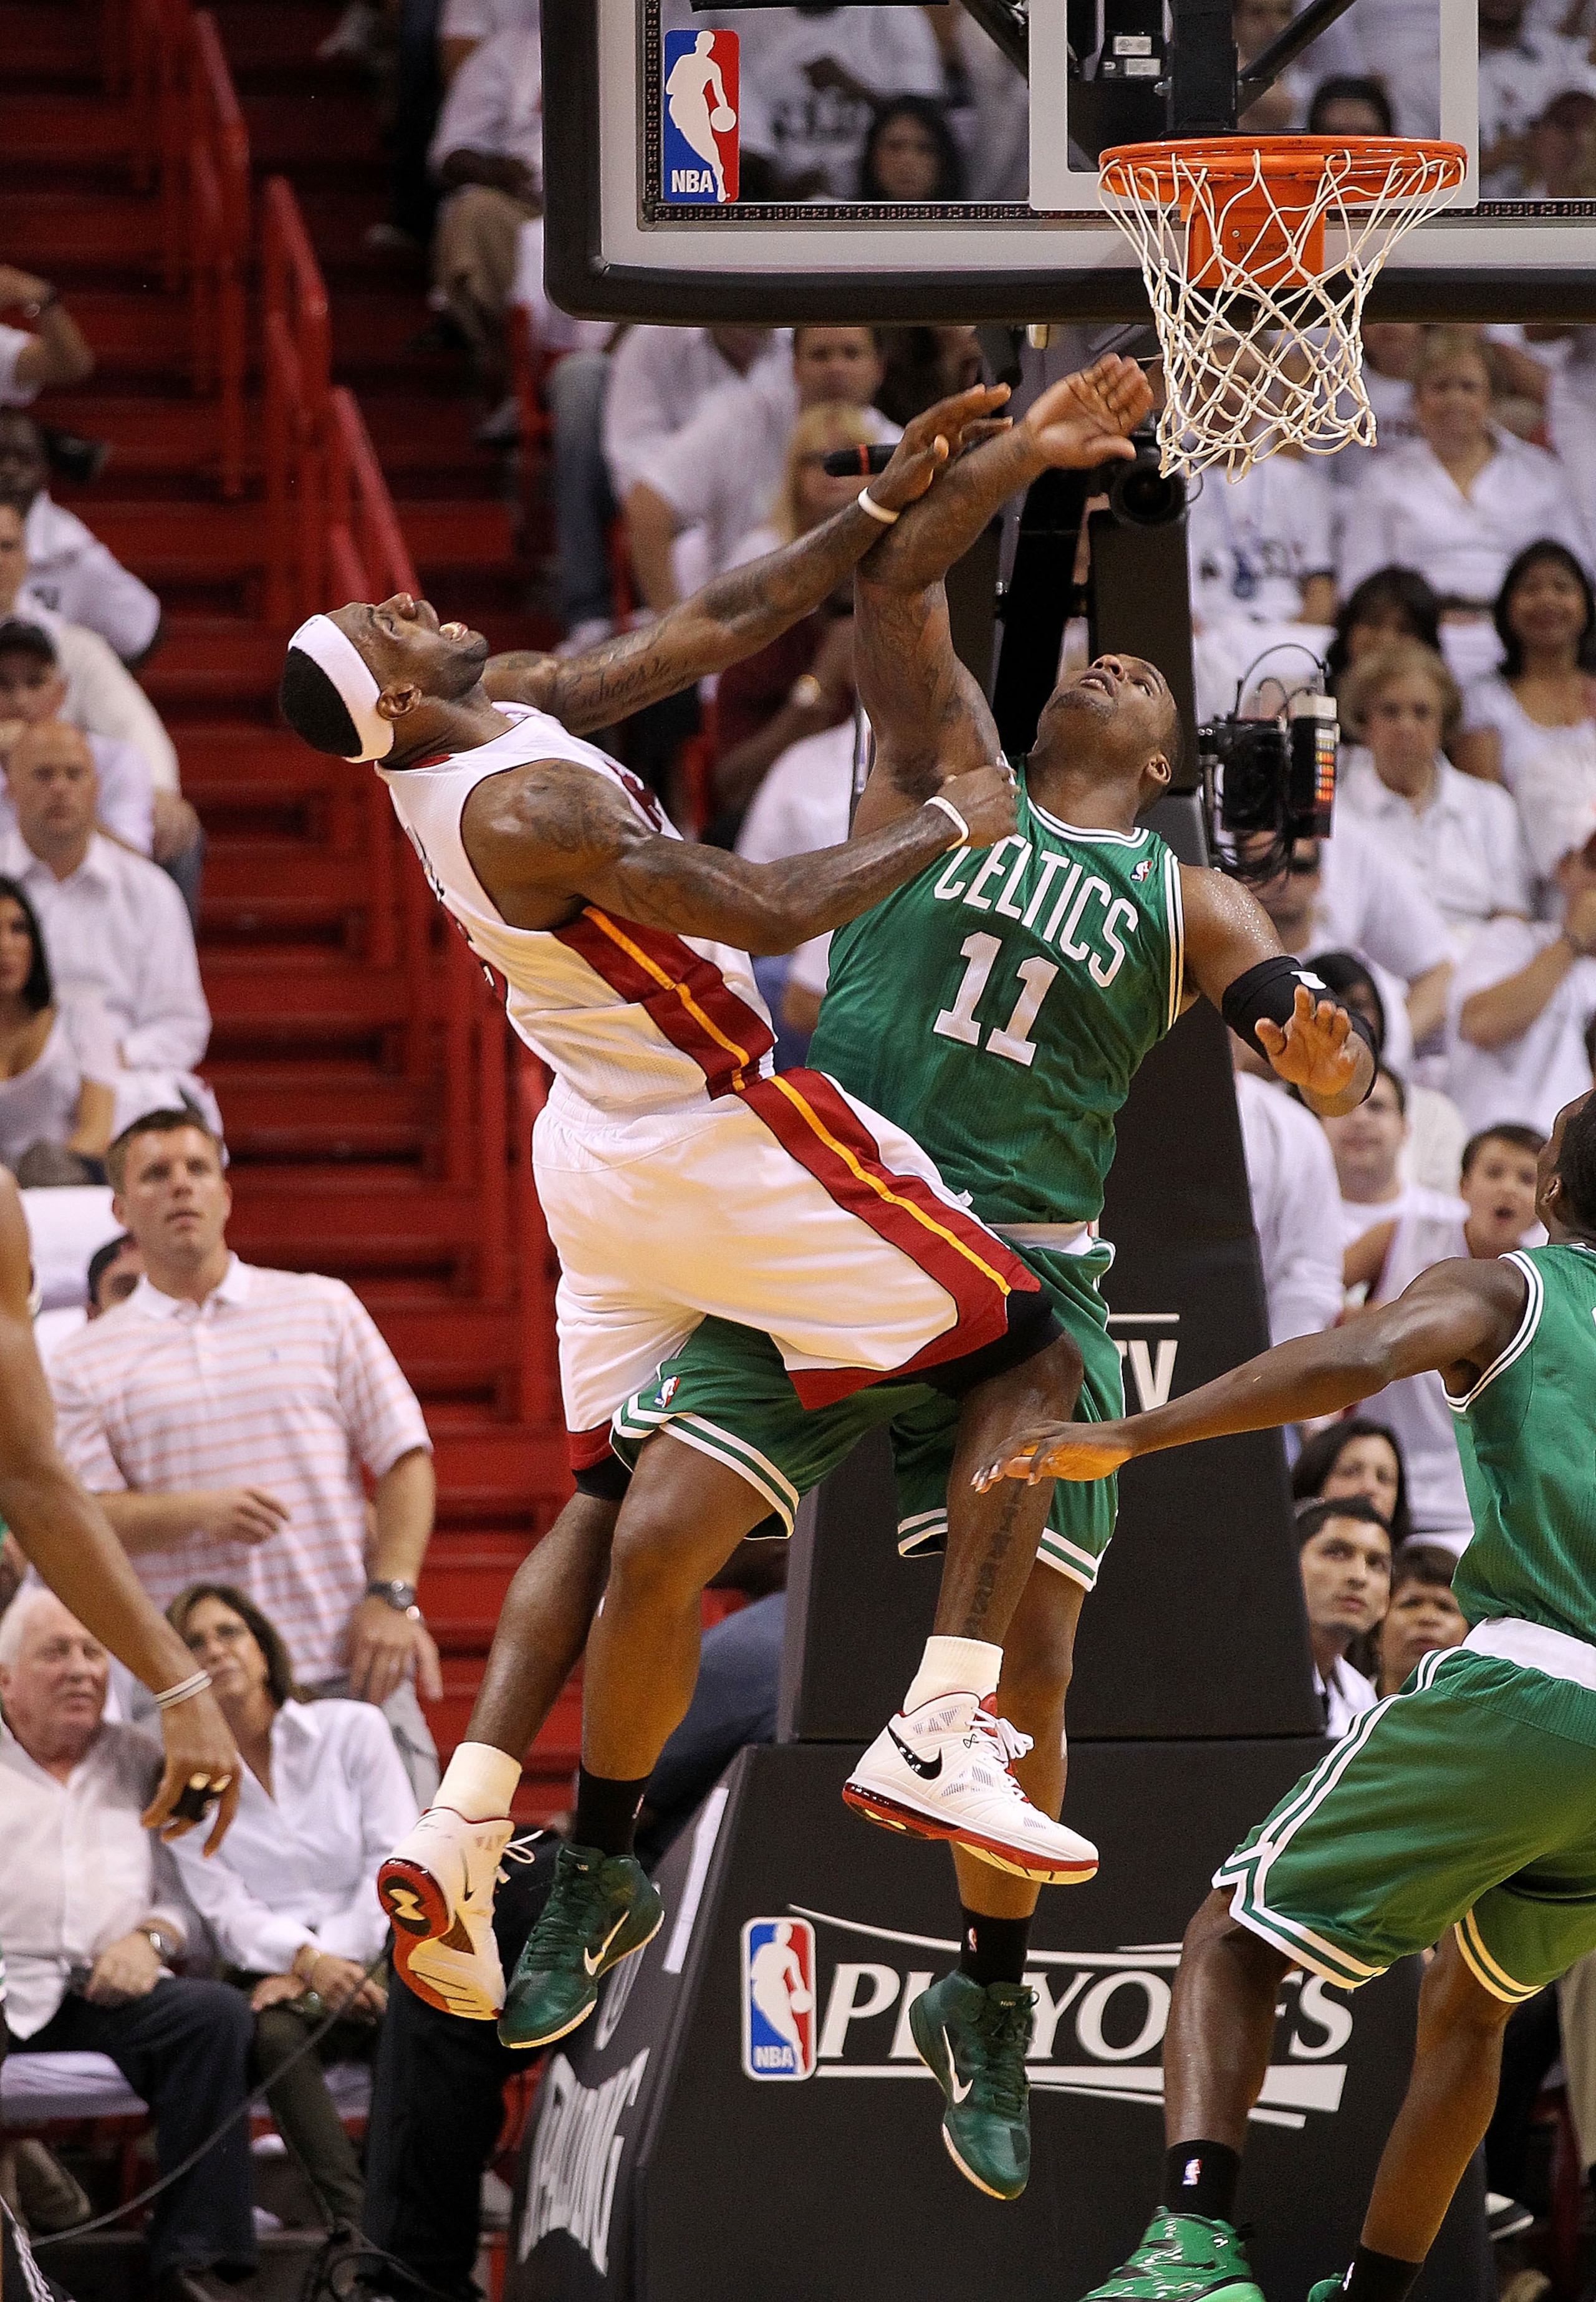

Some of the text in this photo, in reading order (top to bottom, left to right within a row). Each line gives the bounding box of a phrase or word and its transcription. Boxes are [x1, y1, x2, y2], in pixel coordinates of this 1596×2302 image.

[671, 170, 714, 193] NBA
[935, 834, 1139, 988] CELTICS
[933, 931, 1060, 1067] 11
[754, 2046, 794, 2068] NBA
